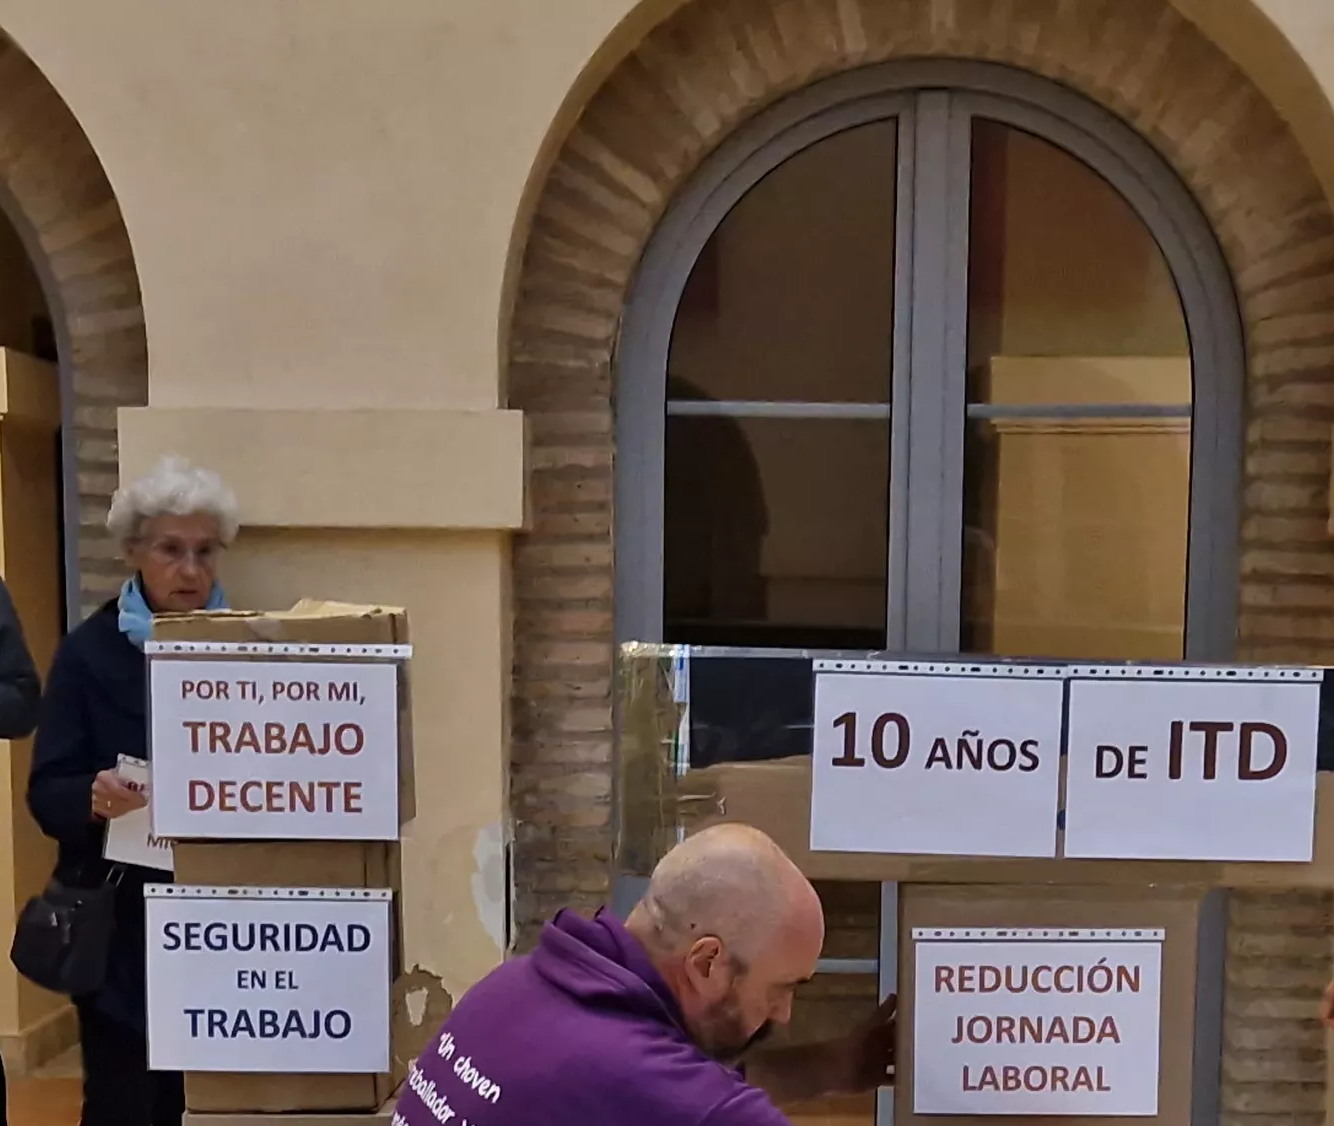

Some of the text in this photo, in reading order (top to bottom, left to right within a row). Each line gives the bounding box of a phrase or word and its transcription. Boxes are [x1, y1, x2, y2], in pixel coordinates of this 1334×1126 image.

[181, 679, 366, 705] POR TI, POR MI,
[182, 721, 365, 756] TRABAJO
[831, 711, 1040, 772] 10 AÑOS
[1095, 720, 1288, 781] DE ITD
[188, 779, 363, 814] DECENTE
[162, 922, 371, 952] SEGURIDAD
[237, 970, 299, 990] EN EL
[934, 957, 1140, 994] REDUCCIÓN
[183, 1009, 353, 1039] TRABAJO
[950, 1015, 1121, 1044] JORNADA
[454, 1056, 501, 1103] choven
[962, 1064, 1112, 1092] LABORAL
